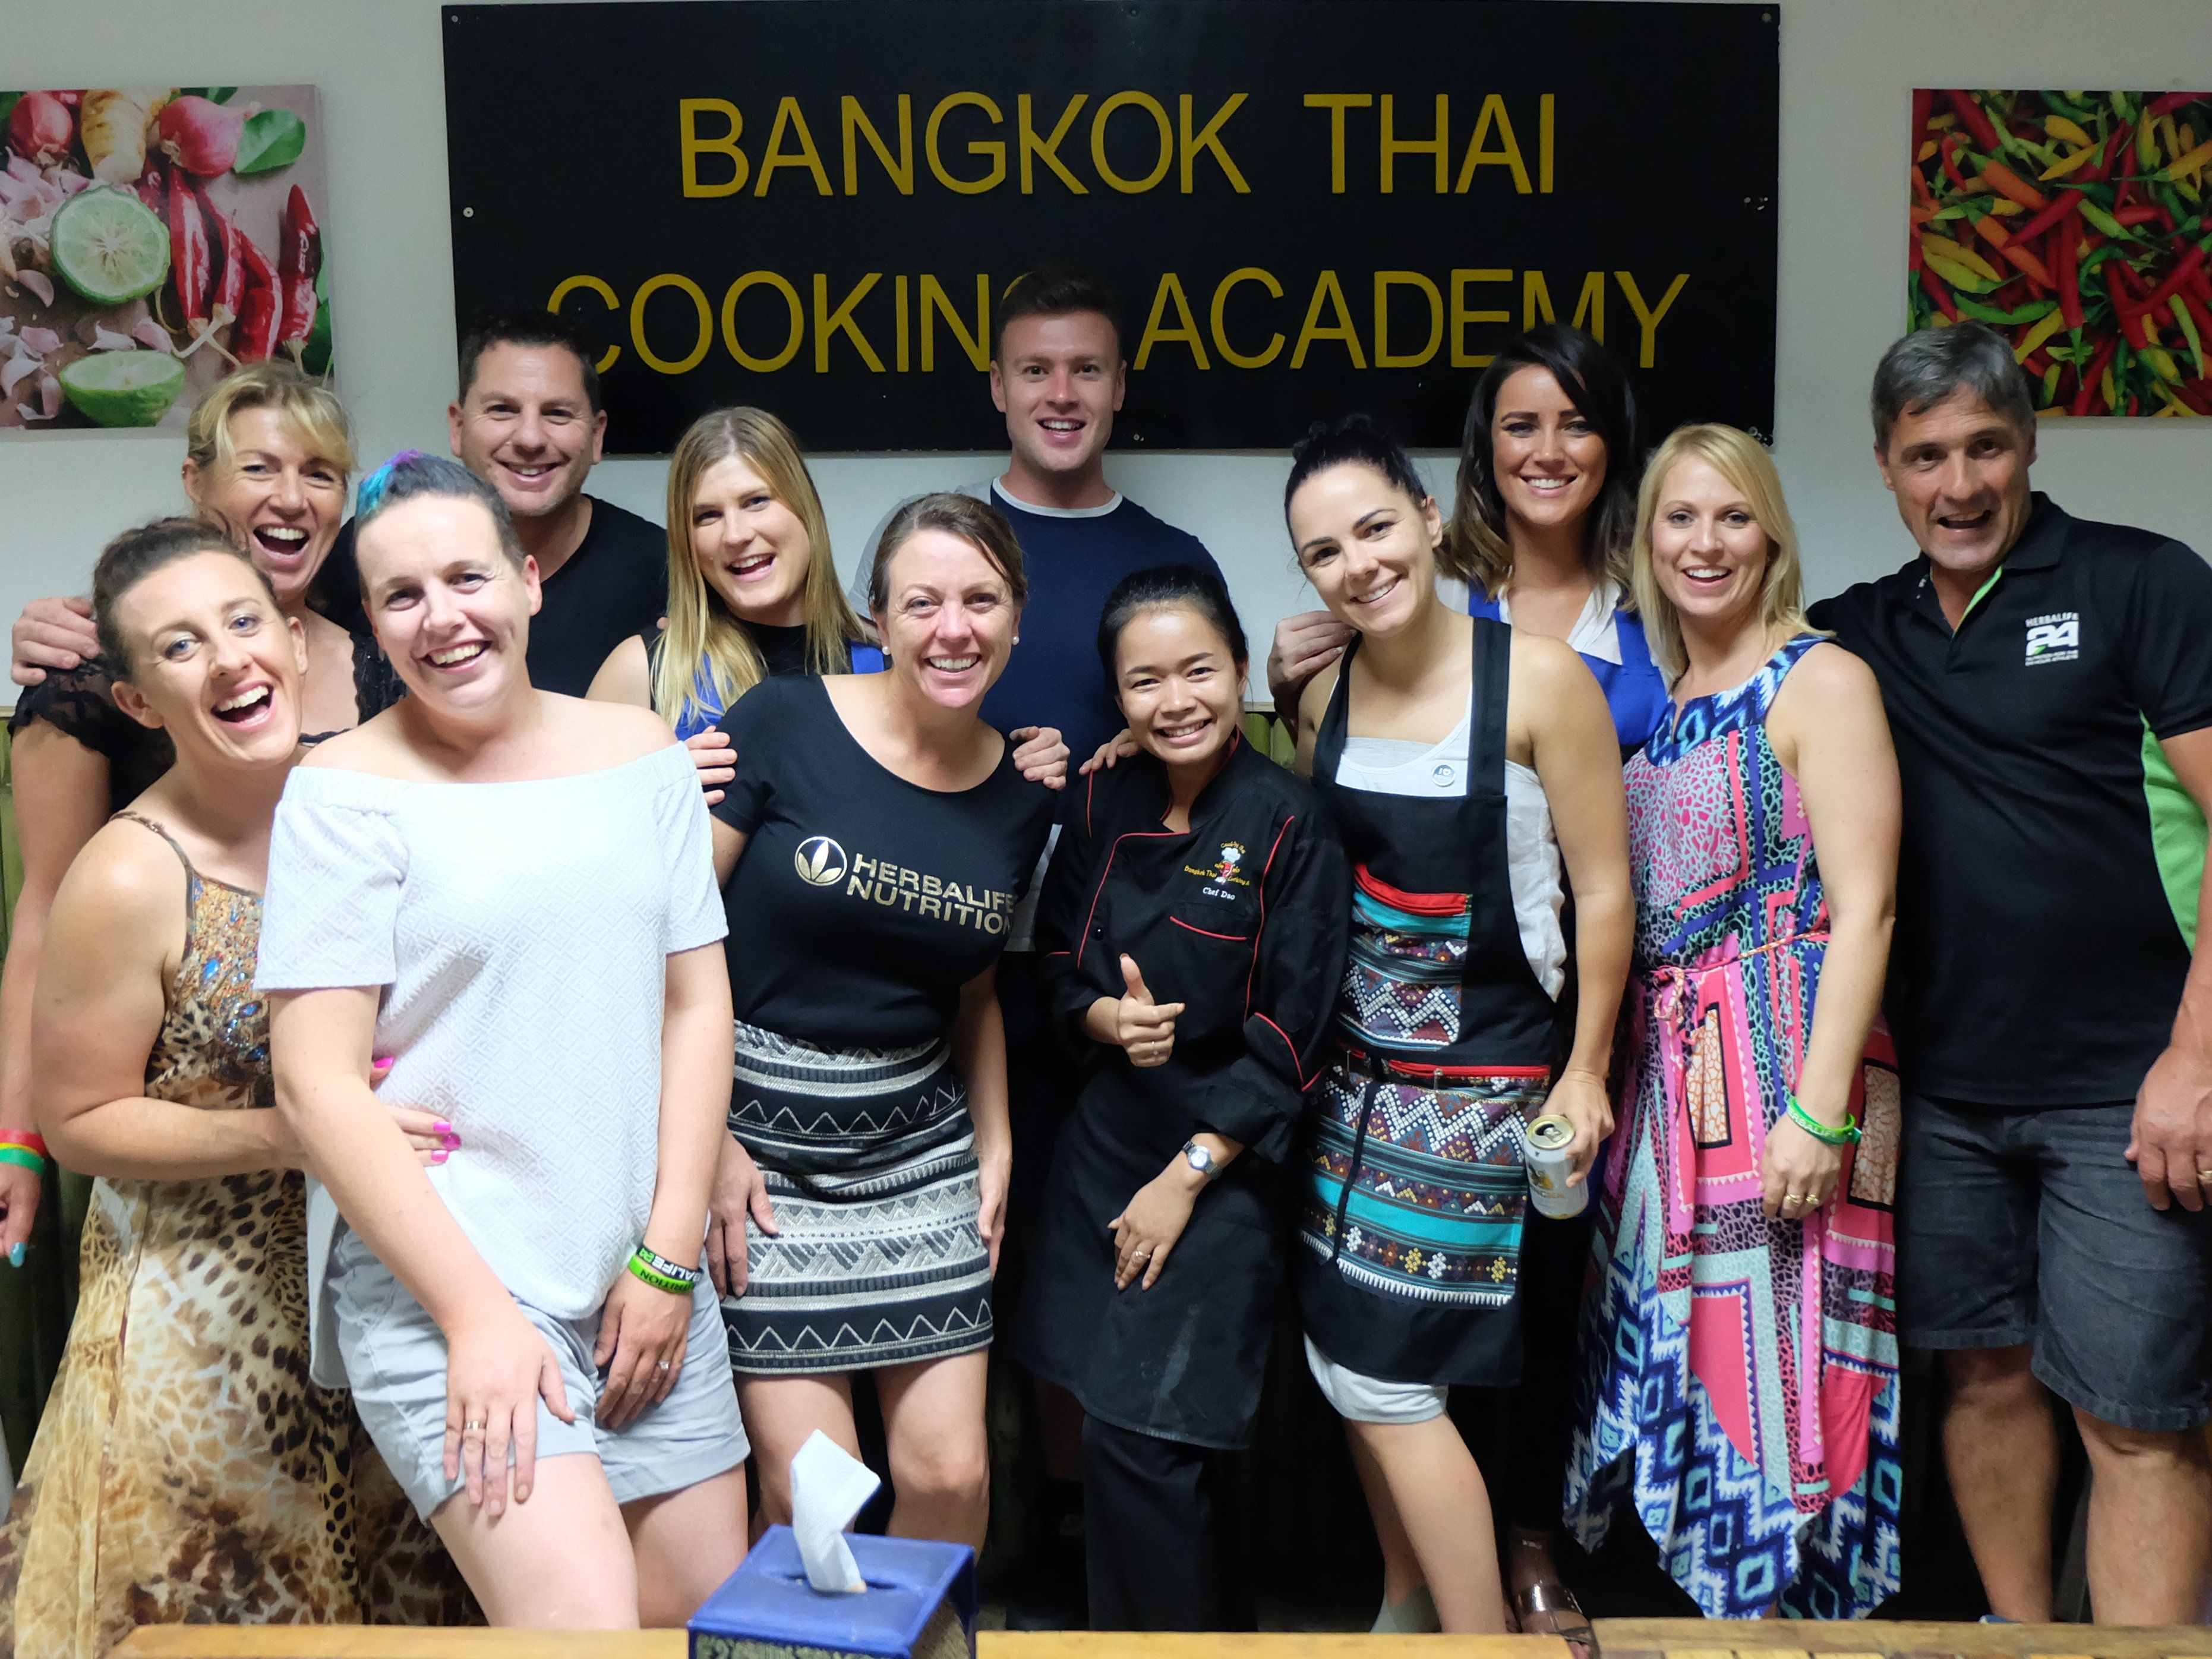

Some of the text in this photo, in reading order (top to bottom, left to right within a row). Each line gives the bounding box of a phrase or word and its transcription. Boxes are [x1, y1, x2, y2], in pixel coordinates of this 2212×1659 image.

[679, 90, 1555, 198] BANGKOK THAI
[547, 267, 1690, 374] COOKIN ACADEMY
[2025, 611, 2080, 627] HERBALIFE
[2025, 621, 2079, 657] 24
[852, 853, 1014, 914] HERBALIFE
[1203, 887, 1236, 901] Chef Dao
